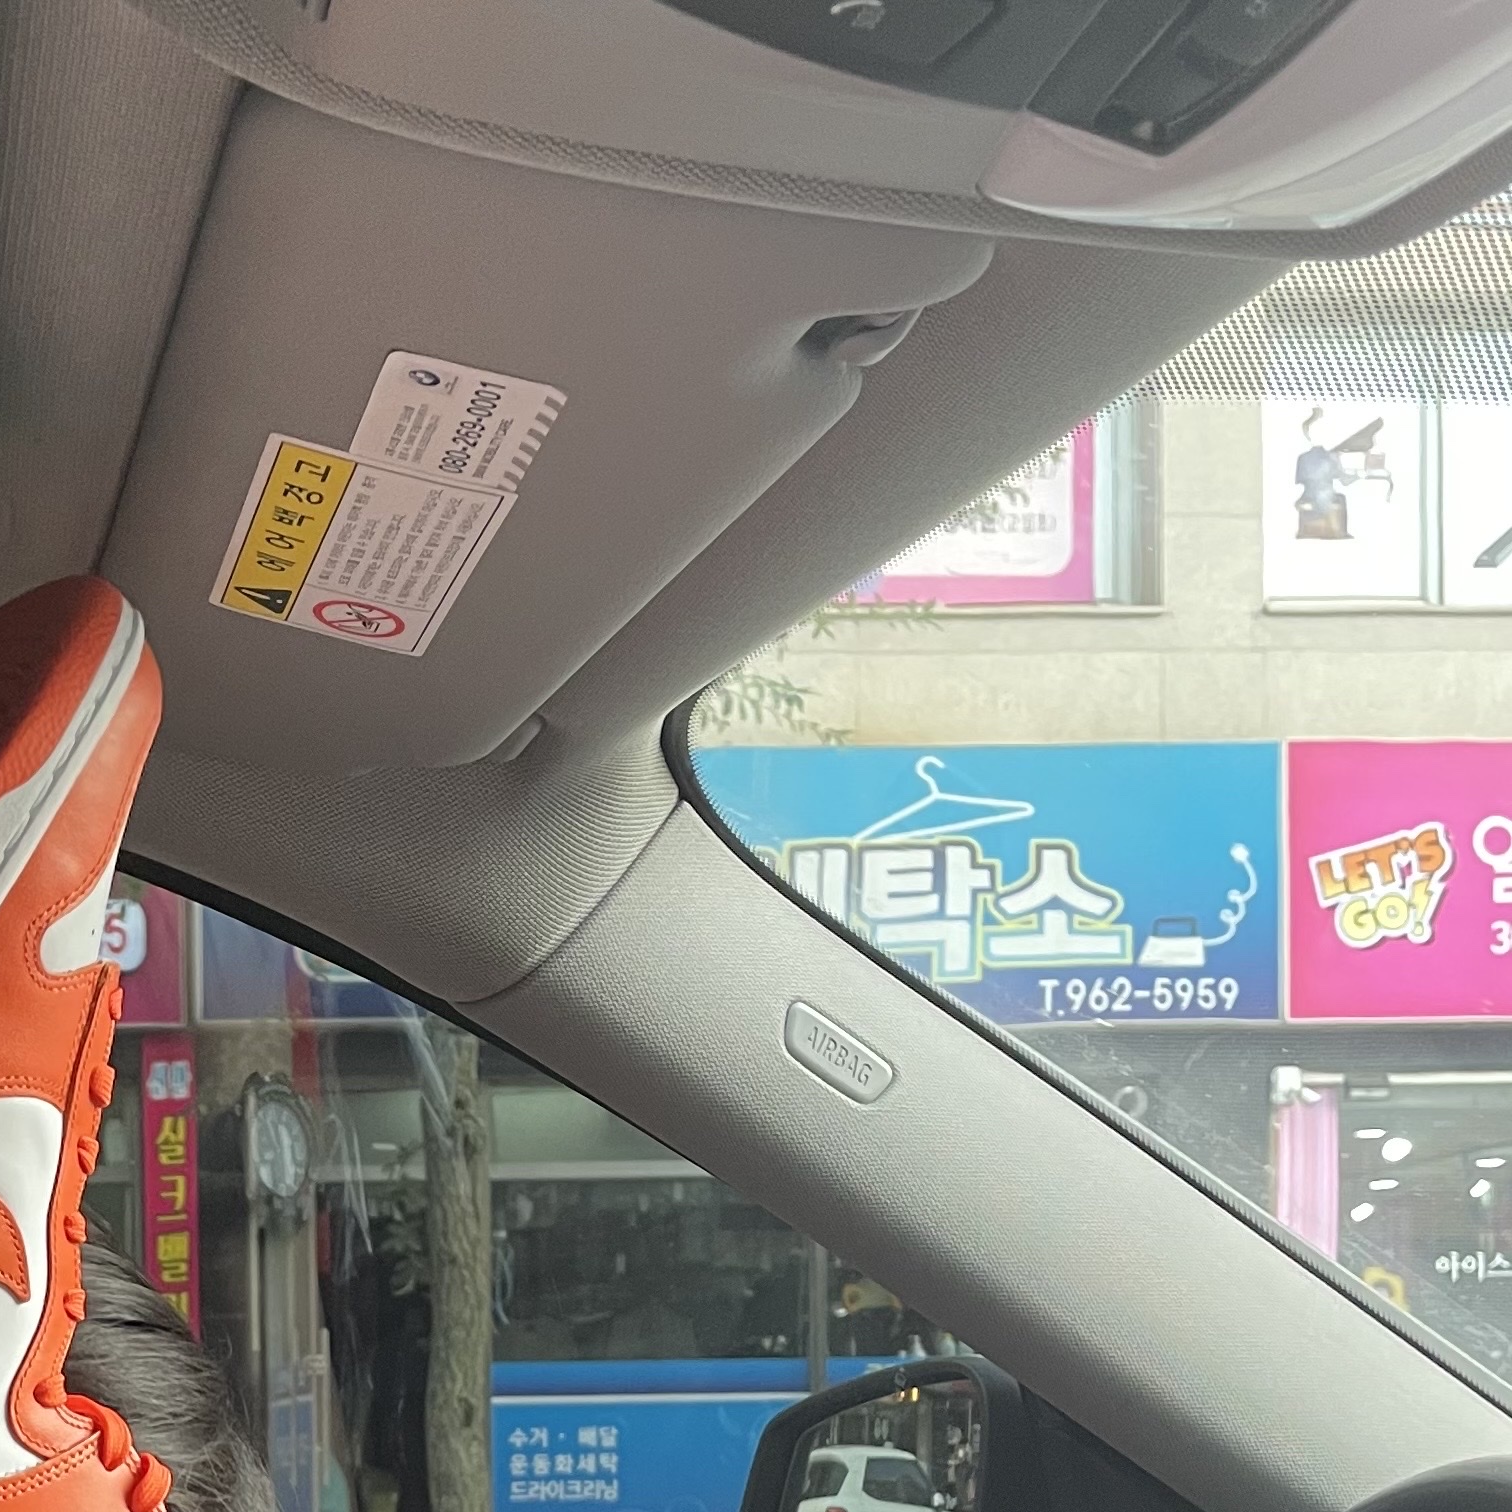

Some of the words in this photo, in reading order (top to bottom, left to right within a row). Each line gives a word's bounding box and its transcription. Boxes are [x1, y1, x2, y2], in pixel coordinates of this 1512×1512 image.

[438, 381, 506, 474] 080-269-0001
[1315, 827, 1446, 901] LET'S
[1339, 879, 1434, 942] GO!
[1489, 919, 1512, 956] 3
[1038, 976, 1240, 1017] T.962-5959
[807, 1025, 874, 1087] AIRBAG
[1434, 1250, 1512, 1283] 아이스
[508, 1427, 549, 1448] 수거
